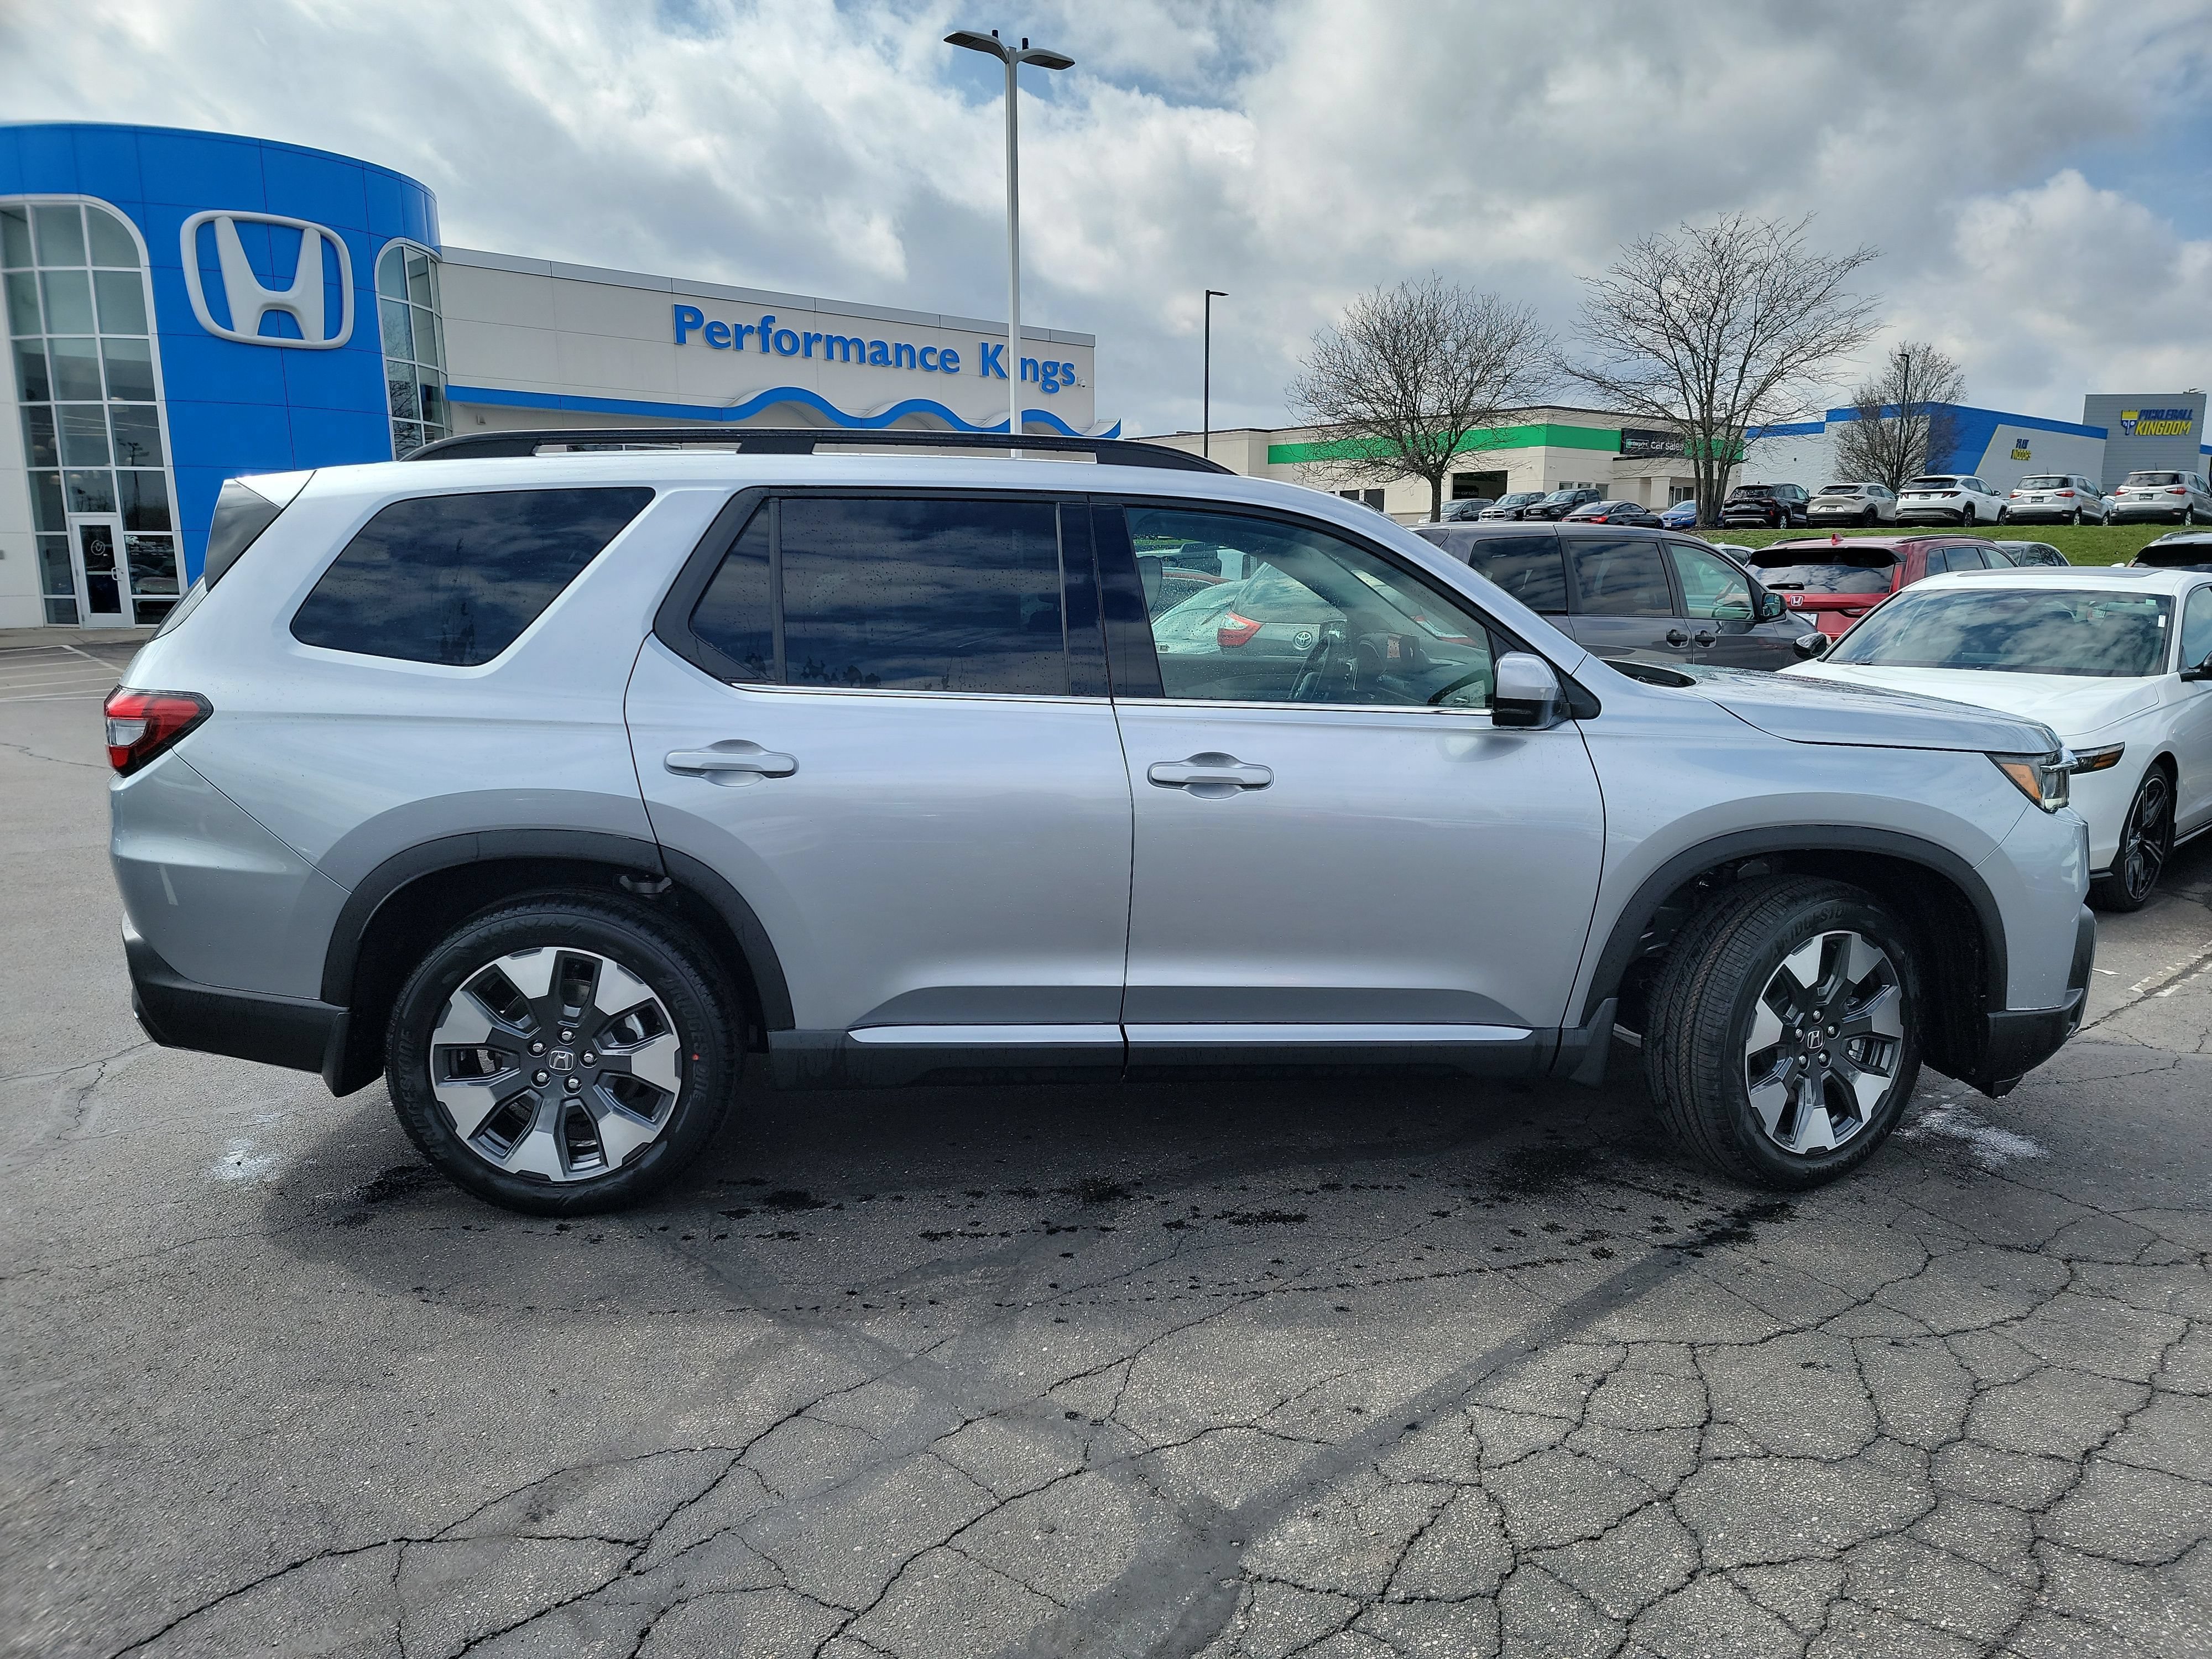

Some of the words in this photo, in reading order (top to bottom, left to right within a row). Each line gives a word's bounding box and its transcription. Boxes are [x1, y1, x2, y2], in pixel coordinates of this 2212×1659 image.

[672, 304, 960, 374] Performance
[979, 341, 1076, 394] Kngs
[2139, 409, 2193, 420] PICKLEBALL
[2135, 421, 2192, 436] KINGDOM
[2011, 449, 2031, 461] INDOORS
